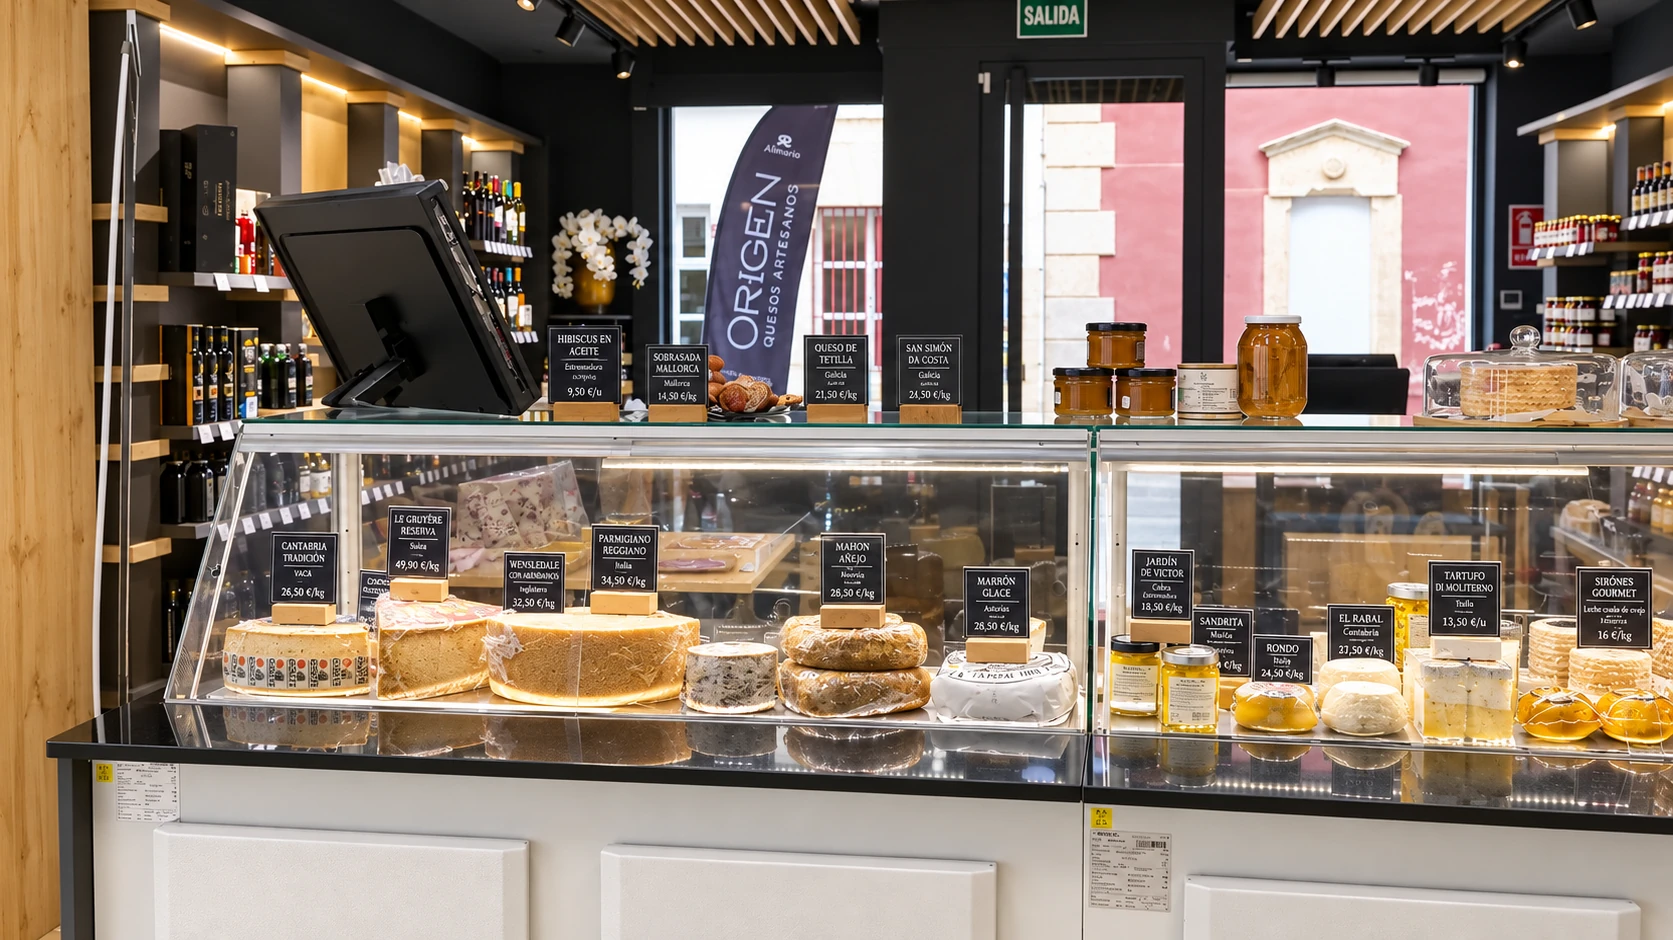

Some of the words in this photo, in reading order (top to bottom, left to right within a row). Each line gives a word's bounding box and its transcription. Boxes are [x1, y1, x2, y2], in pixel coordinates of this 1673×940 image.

[1024, 5, 1080, 25] SALIDA
[727, 172, 782, 350] ORIGEN
[764, 286, 781, 348] QUESOS
[773, 184, 799, 280] ARTESANOS
[557, 335, 598, 343] HIBISCUS
[600, 335, 611, 343] EN
[569, 347, 599, 355] ACEITE
[815, 344, 844, 352] QUESO
[846, 344, 857, 352] DE
[906, 344, 922, 352] SAN
[925, 342, 952, 352] SIMÓN
[653, 353, 701, 361] SOBRASADA
[819, 355, 853, 364] TETILLA
[908, 356, 920, 364] DA
[922, 355, 949, 364] COSTA
[656, 364, 699, 372] MALLORCA
[567, 387, 585, 398] 9,50
[588, 387, 602, 398] €/u
[658, 392, 678, 401] 14,50
[815, 390, 837, 400] 21,50
[839, 390, 858, 401] €/kg
[394, 514, 404, 523] LE
[401, 527, 436, 535] RESERVA
[599, 534, 651, 544] PARMIGIANO
[281, 542, 327, 550] CANTABRIA
[603, 546, 646, 555] REGGIANO
[836, 543, 870, 551] MAHON
[839, 553, 866, 565] AÑEJO
[1146, 556, 1177, 566] JARDÍN
[395, 560, 418, 571] 49,90
[420, 560, 439, 572] €/kg
[509, 560, 560, 569] WENSLEDALE
[1141, 568, 1151, 577] DE
[1154, 569, 1184, 578] VICTOR
[1444, 571, 1485, 580] TARTUFO
[601, 576, 625, 587] 34,50
[627, 576, 646, 588] €/kg
[1595, 575, 1634, 586] SIRÓNES
[1436, 583, 1444, 591] DI
[1446, 583, 1493, 592] MOLITERNO
[281, 587, 304, 598] 26,50
[306, 587, 325, 599] €/kg
[856, 588, 875, 600] €/kg
[982, 588, 1011, 597] GLACE
[1592, 589, 1637, 597] GOURMET
[512, 598, 534, 608] 32,50
[1142, 602, 1163, 613] 18,50
[1165, 603, 1183, 614] €/kg
[1200, 617, 1243, 626] SANDRITA
[1339, 614, 1350, 622] EL
[1353, 614, 1384, 623] RABAL
[1443, 617, 1467, 628] 13,50
[1471, 617, 1486, 628] €/u
[1000, 622, 1019, 633] €/kg
[1598, 630, 1609, 640] 16
[1611, 630, 1632, 642] €/kg
[1266, 644, 1299, 653] RONDO
[1365, 646, 1384, 657] €/kg
